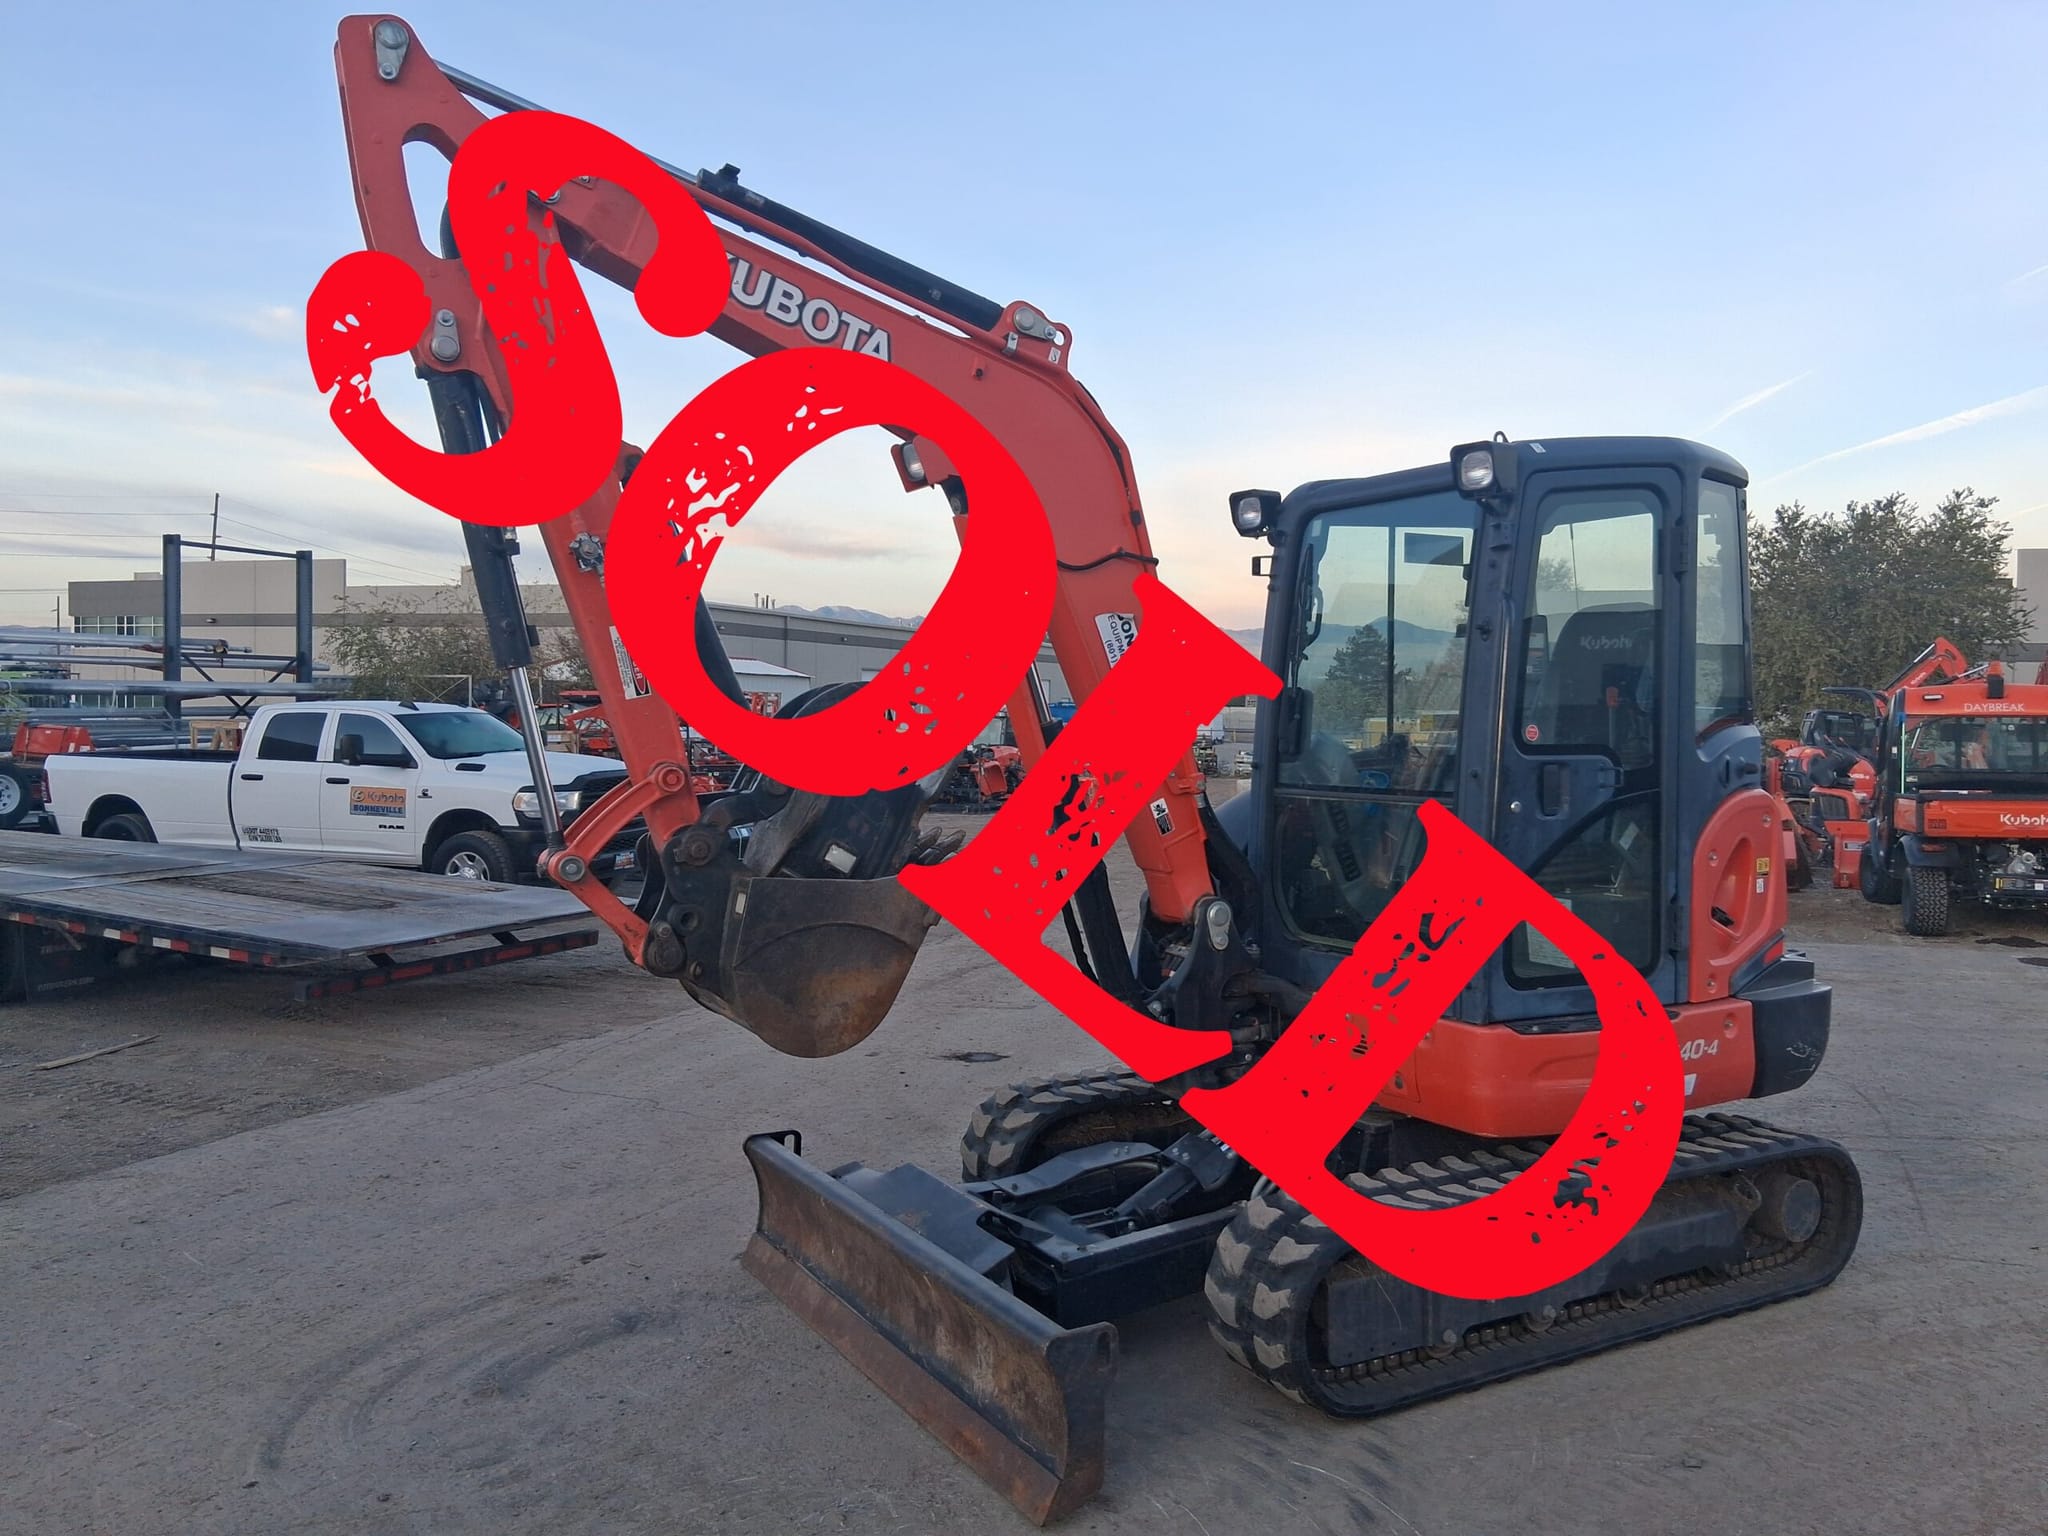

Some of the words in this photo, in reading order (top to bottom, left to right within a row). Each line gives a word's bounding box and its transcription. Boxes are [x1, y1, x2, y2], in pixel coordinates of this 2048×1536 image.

[726, 251, 893, 362] UBOTA
[1108, 614, 1126, 656] EQUIPM
[1105, 639, 1118, 664] (801)
[1963, 703, 2024, 712] DAYBREAK
[367, 791, 404, 803] Kubota
[353, 804, 404, 814] BONNEVILLE
